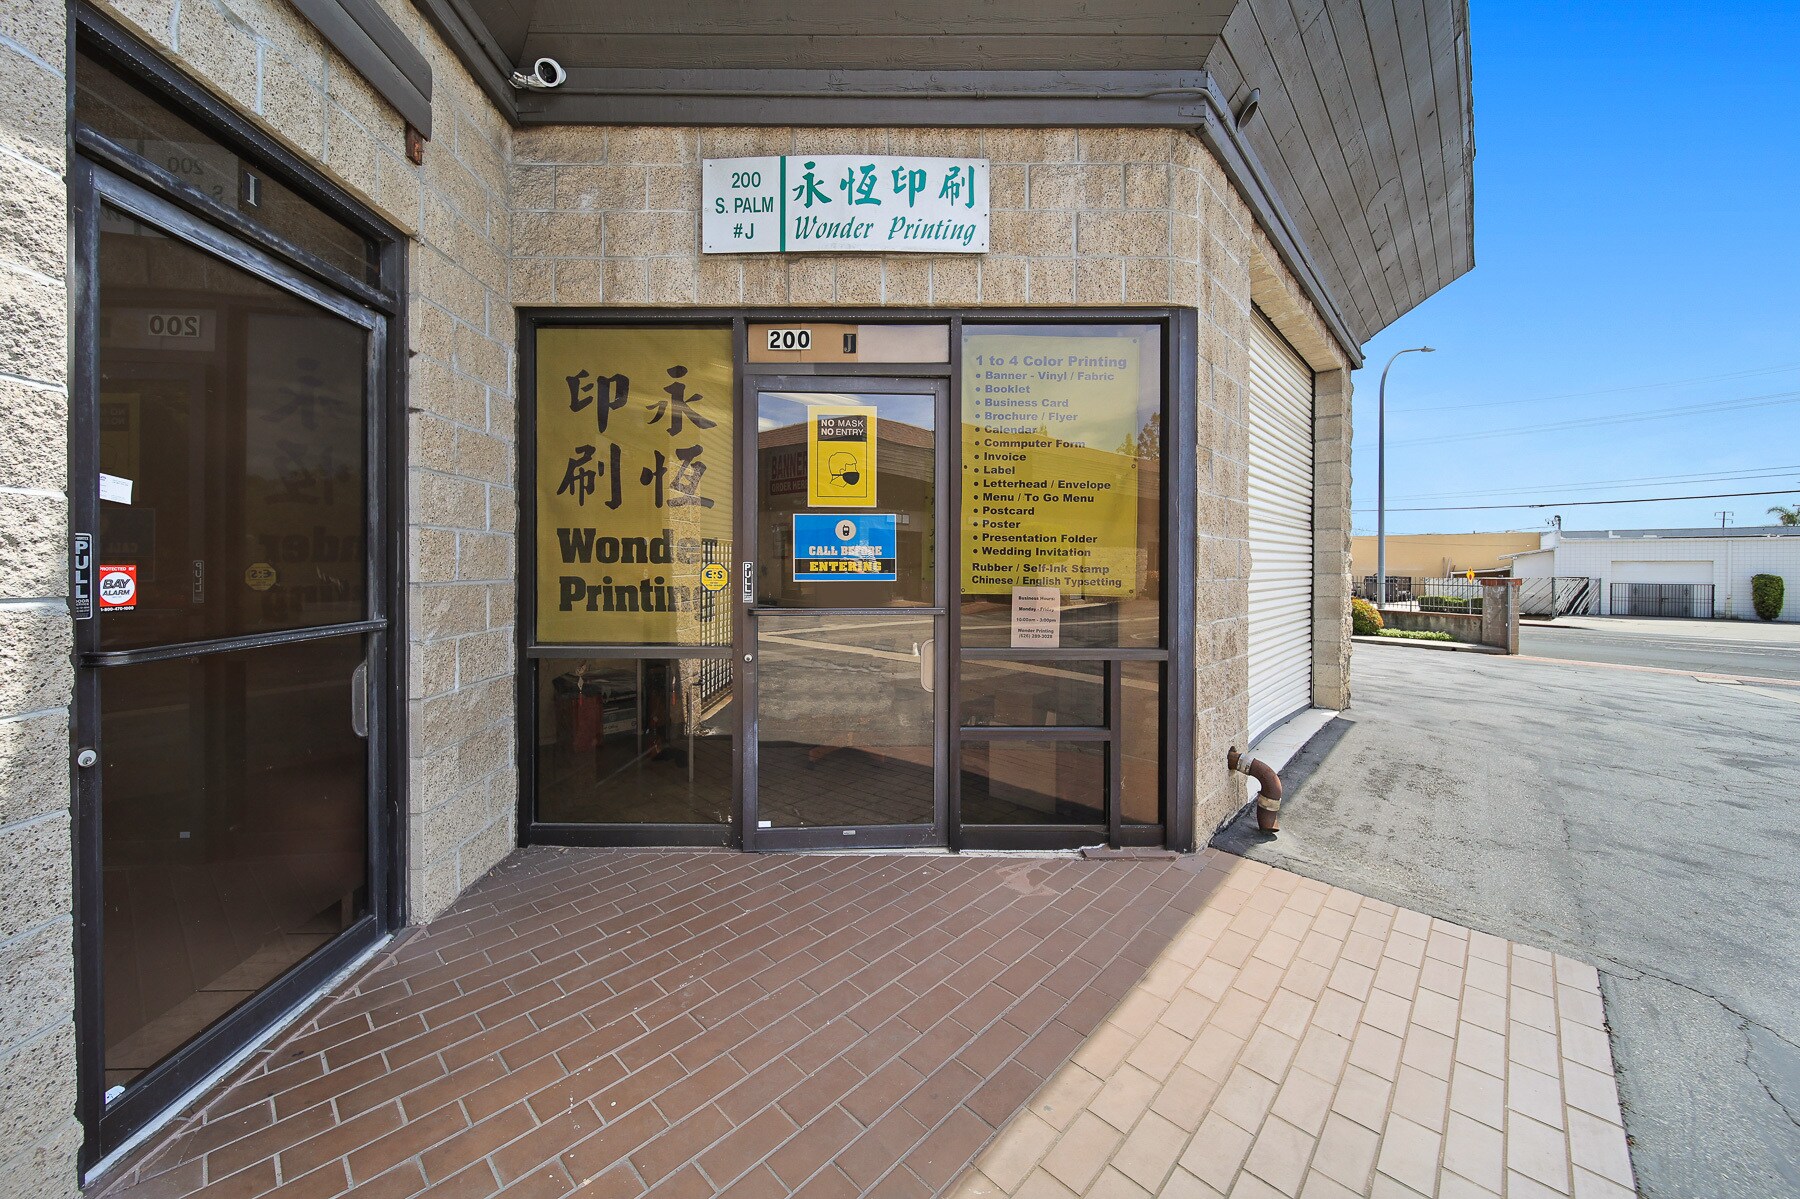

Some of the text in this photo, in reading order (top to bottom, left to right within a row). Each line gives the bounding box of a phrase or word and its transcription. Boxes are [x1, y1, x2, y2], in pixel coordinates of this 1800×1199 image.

[731, 171, 762, 189] 200
[715, 196, 774, 214] S. PALM
[733, 222, 755, 240] #J
[794, 214, 977, 247] Wonder Printing
[769, 330, 810, 349] 200
[843, 334, 853, 353] J
[976, 355, 1127, 370] 1 to 4 Color Printing
[985, 371, 1027, 380] Banner
[1038, 371, 1067, 381] Vinyl
[1077, 371, 1115, 381] Fabric
[985, 384, 1031, 394] Booklet
[984, 398, 1069, 408] Business Card
[984, 411, 1038, 421] Brochure
[1048, 412, 1078, 423] Flyer
[821, 419, 864, 428] NO MASK
[821, 428, 864, 436] NO ENTRY
[984, 425, 1037, 434] Calendar
[984, 438, 1086, 449] Commputer Form
[983, 452, 1027, 461] Invoice
[983, 465, 1015, 475] Label
[983, 479, 1047, 489] Letterhead
[1058, 480, 1111, 491] Envelope
[982, 493, 1014, 502] Menu
[1024, 493, 1039, 502] To
[1043, 493, 1059, 503] Go
[1063, 493, 1094, 503] Menu
[982, 506, 1035, 516] Postcard
[982, 519, 1021, 529] Poster
[982, 533, 1098, 544] Presentation Folder
[809, 545, 838, 556] CALL
[982, 547, 1091, 557] Wedding Invitation
[75, 541, 89, 598] PULL
[809, 561, 882, 572] ENTERING
[972, 562, 1013, 572] Rubber
[1023, 563, 1068, 573] Self-Ink
[1071, 564, 1110, 575] Stamp
[744, 563, 752, 593] PULL
[971, 575, 1013, 585] Chinese
[1022, 577, 1061, 587] English
[1064, 577, 1122, 588] Typsetting
[103, 579, 131, 589] BAY
